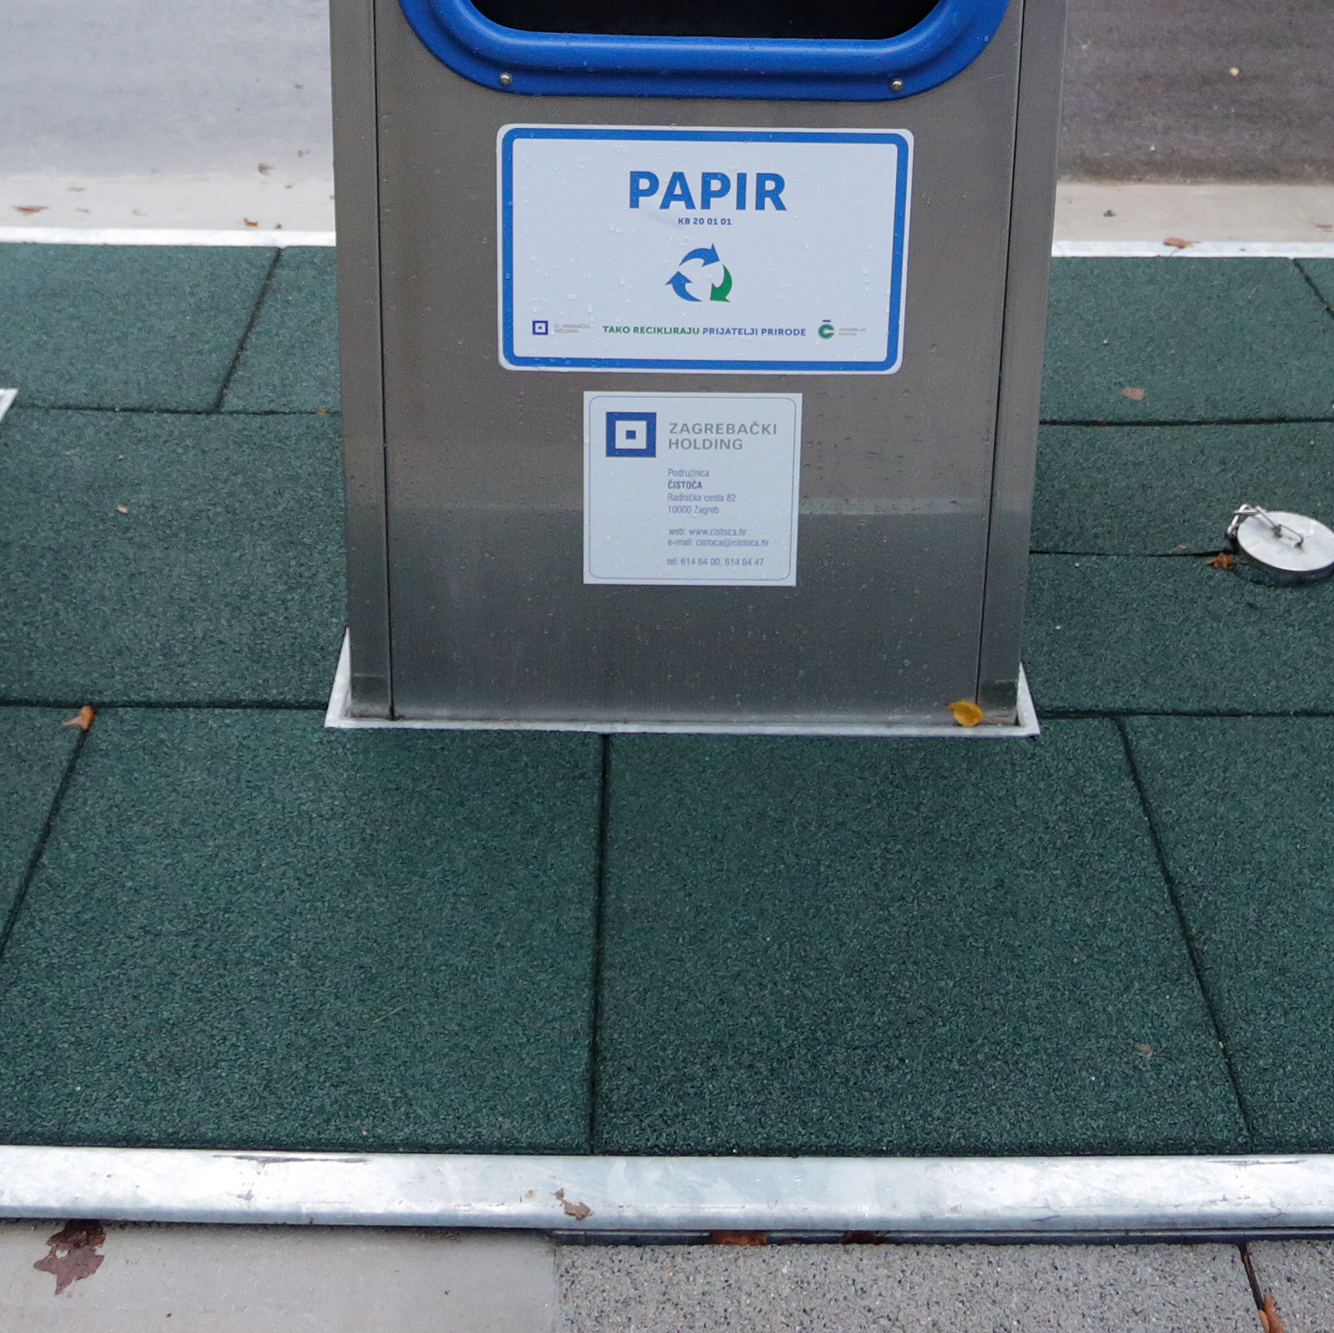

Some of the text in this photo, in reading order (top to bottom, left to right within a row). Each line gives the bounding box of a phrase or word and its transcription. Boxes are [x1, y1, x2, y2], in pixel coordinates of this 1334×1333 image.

[629, 171, 787, 211] PAPIR
[677, 217, 732, 226] KB 20 01 01
[602, 325, 631, 334] TAKO
[632, 325, 700, 335] RECIKLIRAJU
[702, 326, 759, 336] PRIJATELJI
[760, 327, 807, 337] PRIRODE
[668, 420, 778, 435] ZAGREBAČKI
[668, 438, 744, 451] HOLDING
[667, 468, 710, 478] Podružnica
[667, 492, 737, 503] Radnička cesta 82
[668, 505, 720, 515] 10000 Zagreb
[689, 527, 748, 536] www.cistoca.hr
[680, 557, 696, 566] 614
[698, 557, 708, 566] 64
[724, 557, 740, 566] 614
[741, 557, 752, 566] 64
[754, 557, 765, 566] 47
